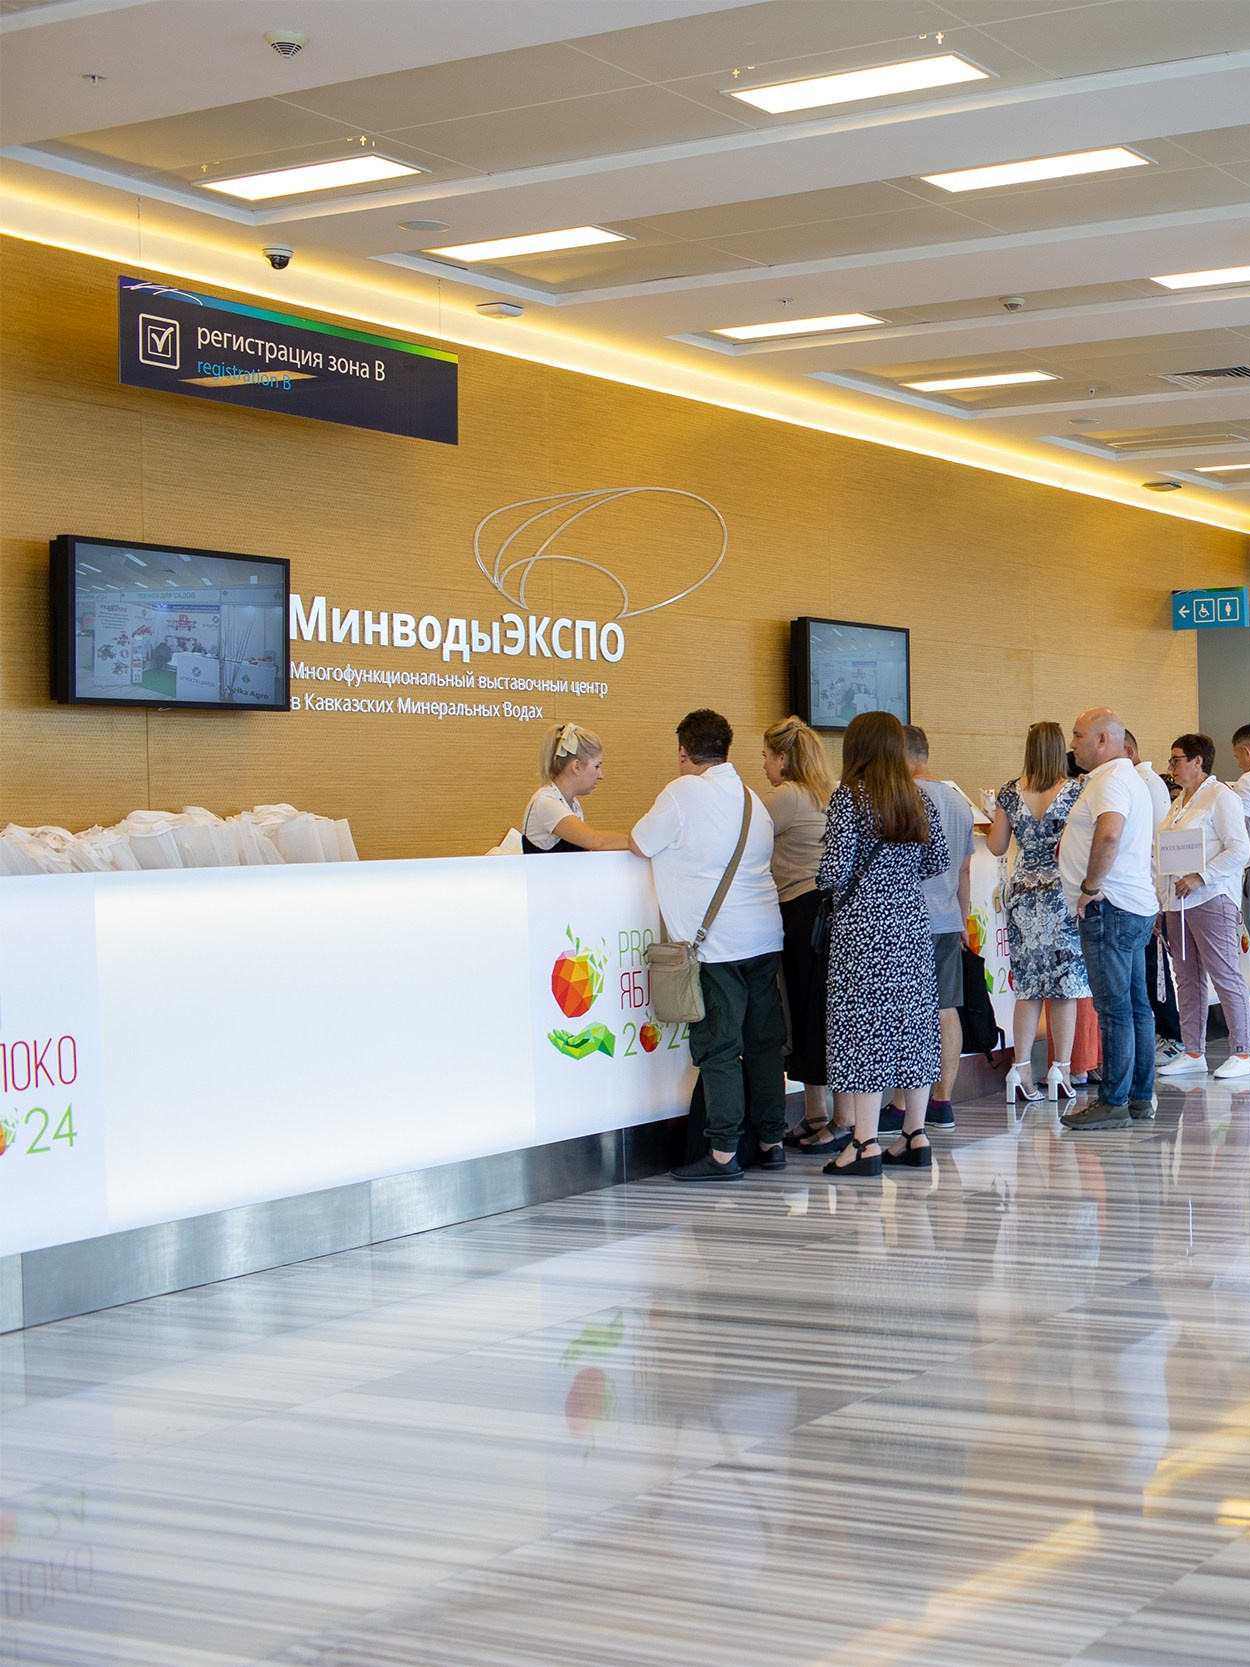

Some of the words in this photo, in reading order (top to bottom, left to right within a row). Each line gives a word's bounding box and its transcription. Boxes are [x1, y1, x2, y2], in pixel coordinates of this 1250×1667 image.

[197, 326, 324, 369] регистрация
[328, 355, 371, 379] зона
[197, 360, 279, 389] registration
[282, 373, 292, 391] B
[290, 660, 475, 688] Многофункциональный
[477, 675, 569, 693] выставочный
[571, 680, 609, 699] центр
[291, 695, 301, 711] в
[304, 692, 395, 714] Кавказских
[397, 697, 501, 720] Минеральных
[503, 701, 544, 722] Водах
